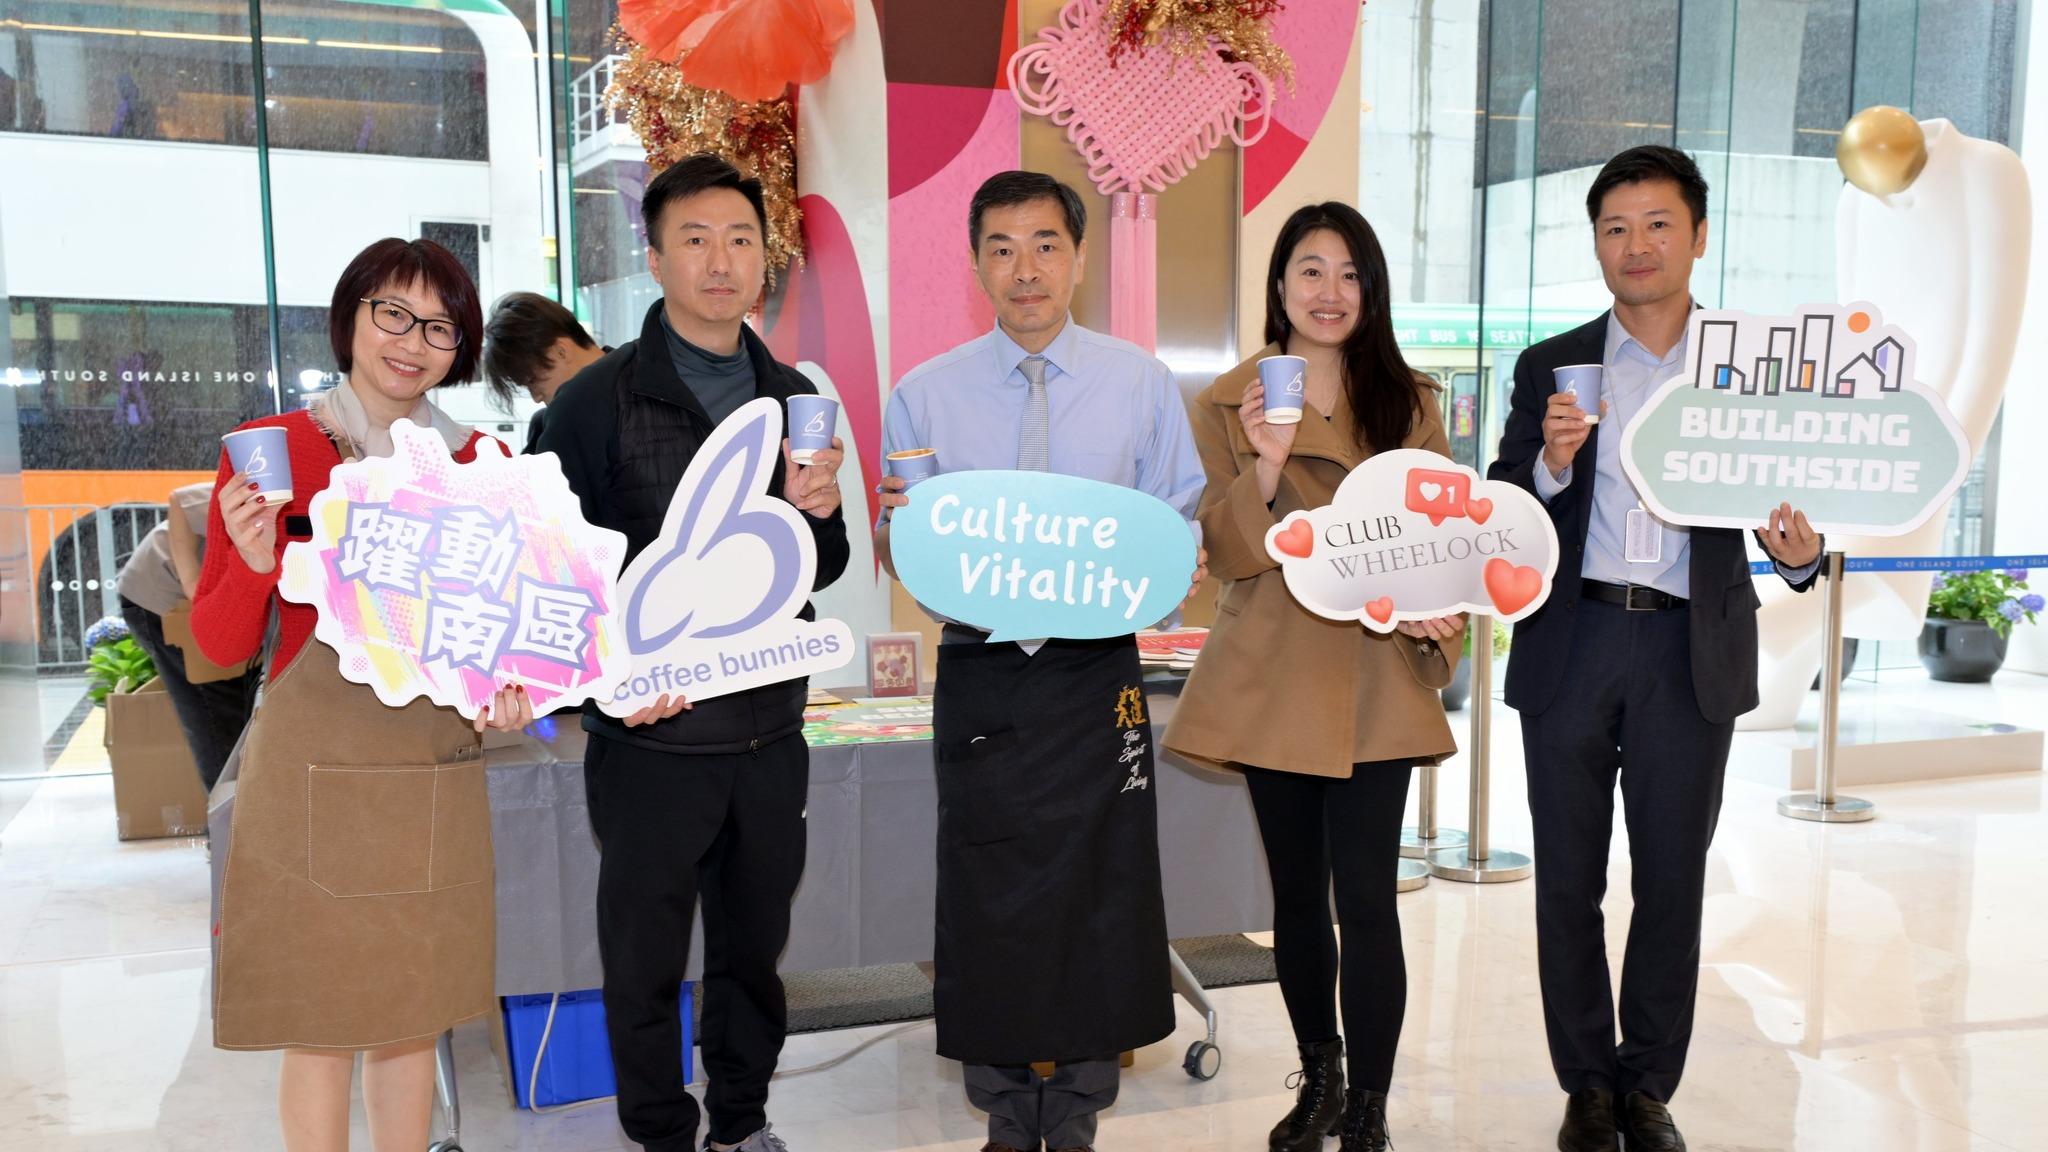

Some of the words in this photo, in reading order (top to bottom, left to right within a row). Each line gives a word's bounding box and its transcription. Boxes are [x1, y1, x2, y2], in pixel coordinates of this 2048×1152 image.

[1429, 329, 1457, 343] BUS
[1679, 406, 1911, 447] BUILDING
[1661, 450, 1921, 494] SOUTHSIDE
[1446, 485, 1456, 504] 1
[930, 493, 1119, 549] Culture
[1325, 515, 1402, 548] CLUB
[335, 503, 523, 597] 躍動
[1328, 527, 1521, 580] WHEELOCK
[1896, 560, 1915, 568] ONE
[1919, 560, 1952, 568] ISLAND
[1956, 560, 1985, 568] SOUTH
[959, 552, 1150, 620] Vitality
[424, 575, 600, 678] 南區
[614, 662, 713, 701] coffee
[719, 634, 840, 677] bunnies
[1123, 730, 1141, 746] The
